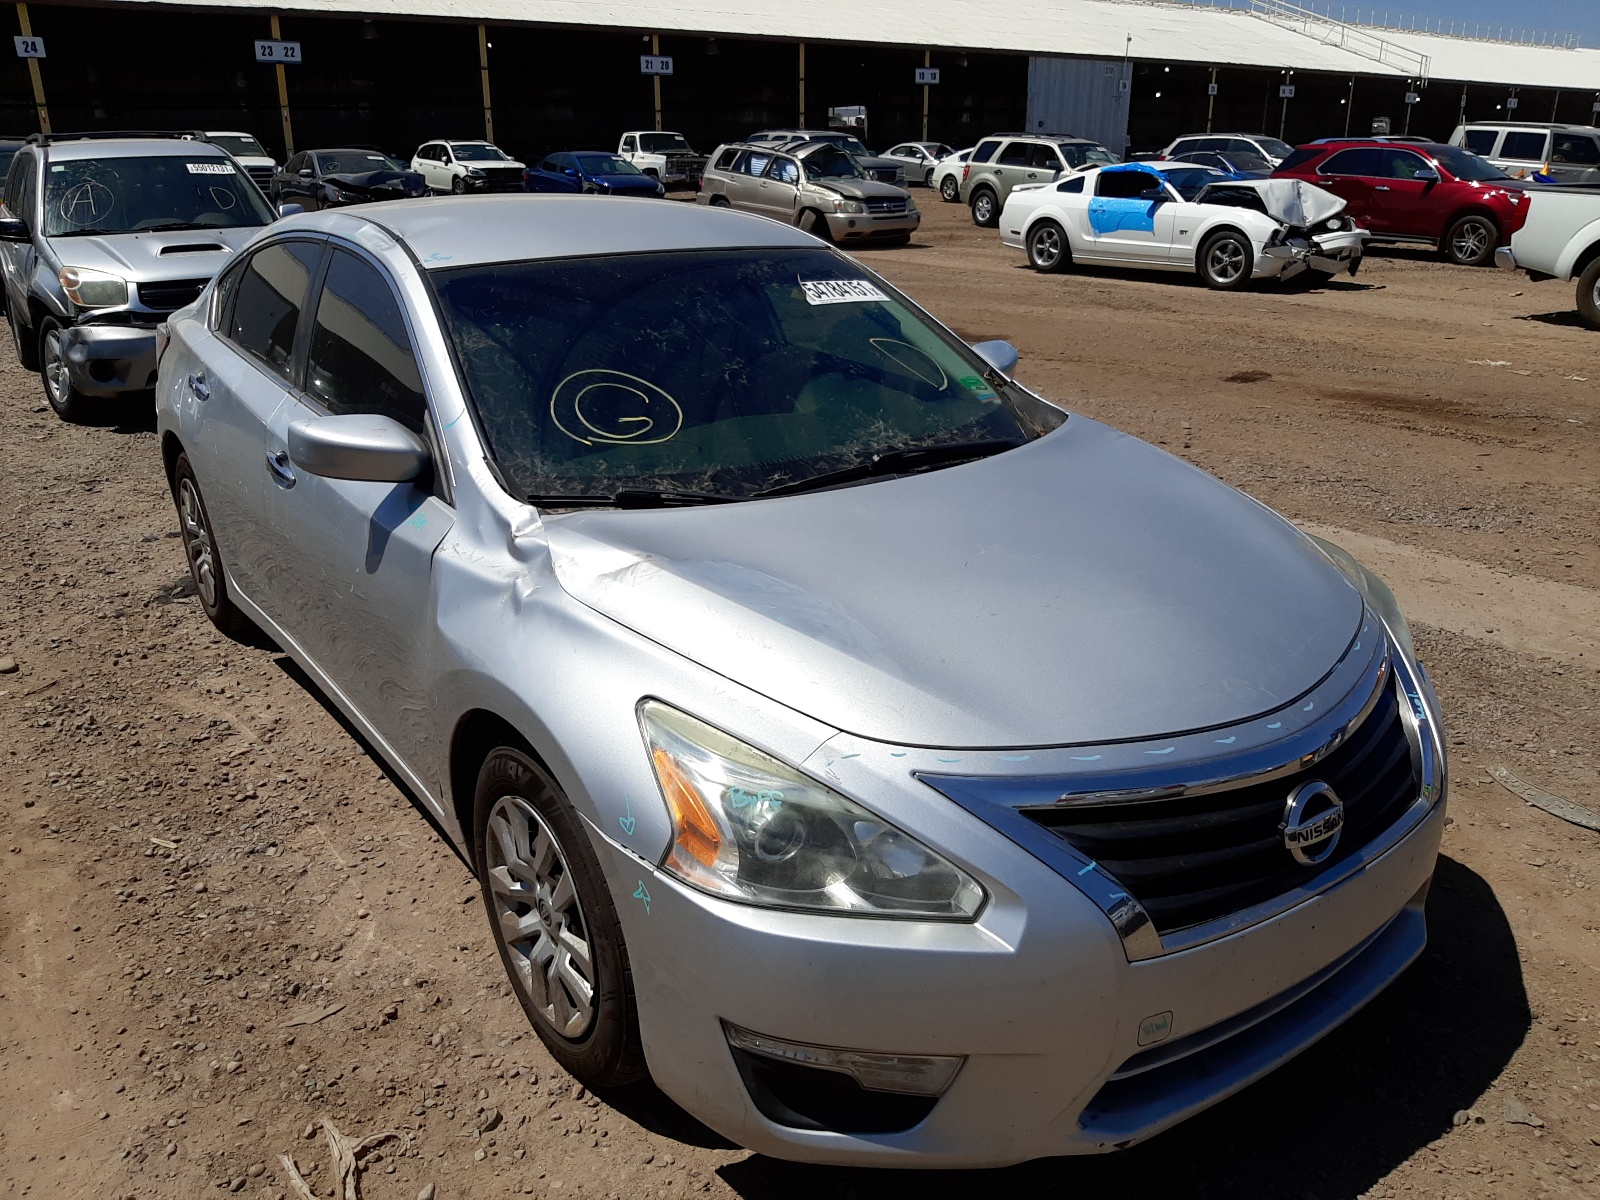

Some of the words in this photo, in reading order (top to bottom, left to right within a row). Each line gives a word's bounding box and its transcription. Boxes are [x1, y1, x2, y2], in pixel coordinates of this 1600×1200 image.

[22, 40, 38, 53] 24
[260, 45, 273, 57] 23
[283, 46, 296, 58] 22
[645, 59, 653, 70] 21
[660, 60, 670, 70] 20
[1296, 812, 1344, 844] NISSAN
